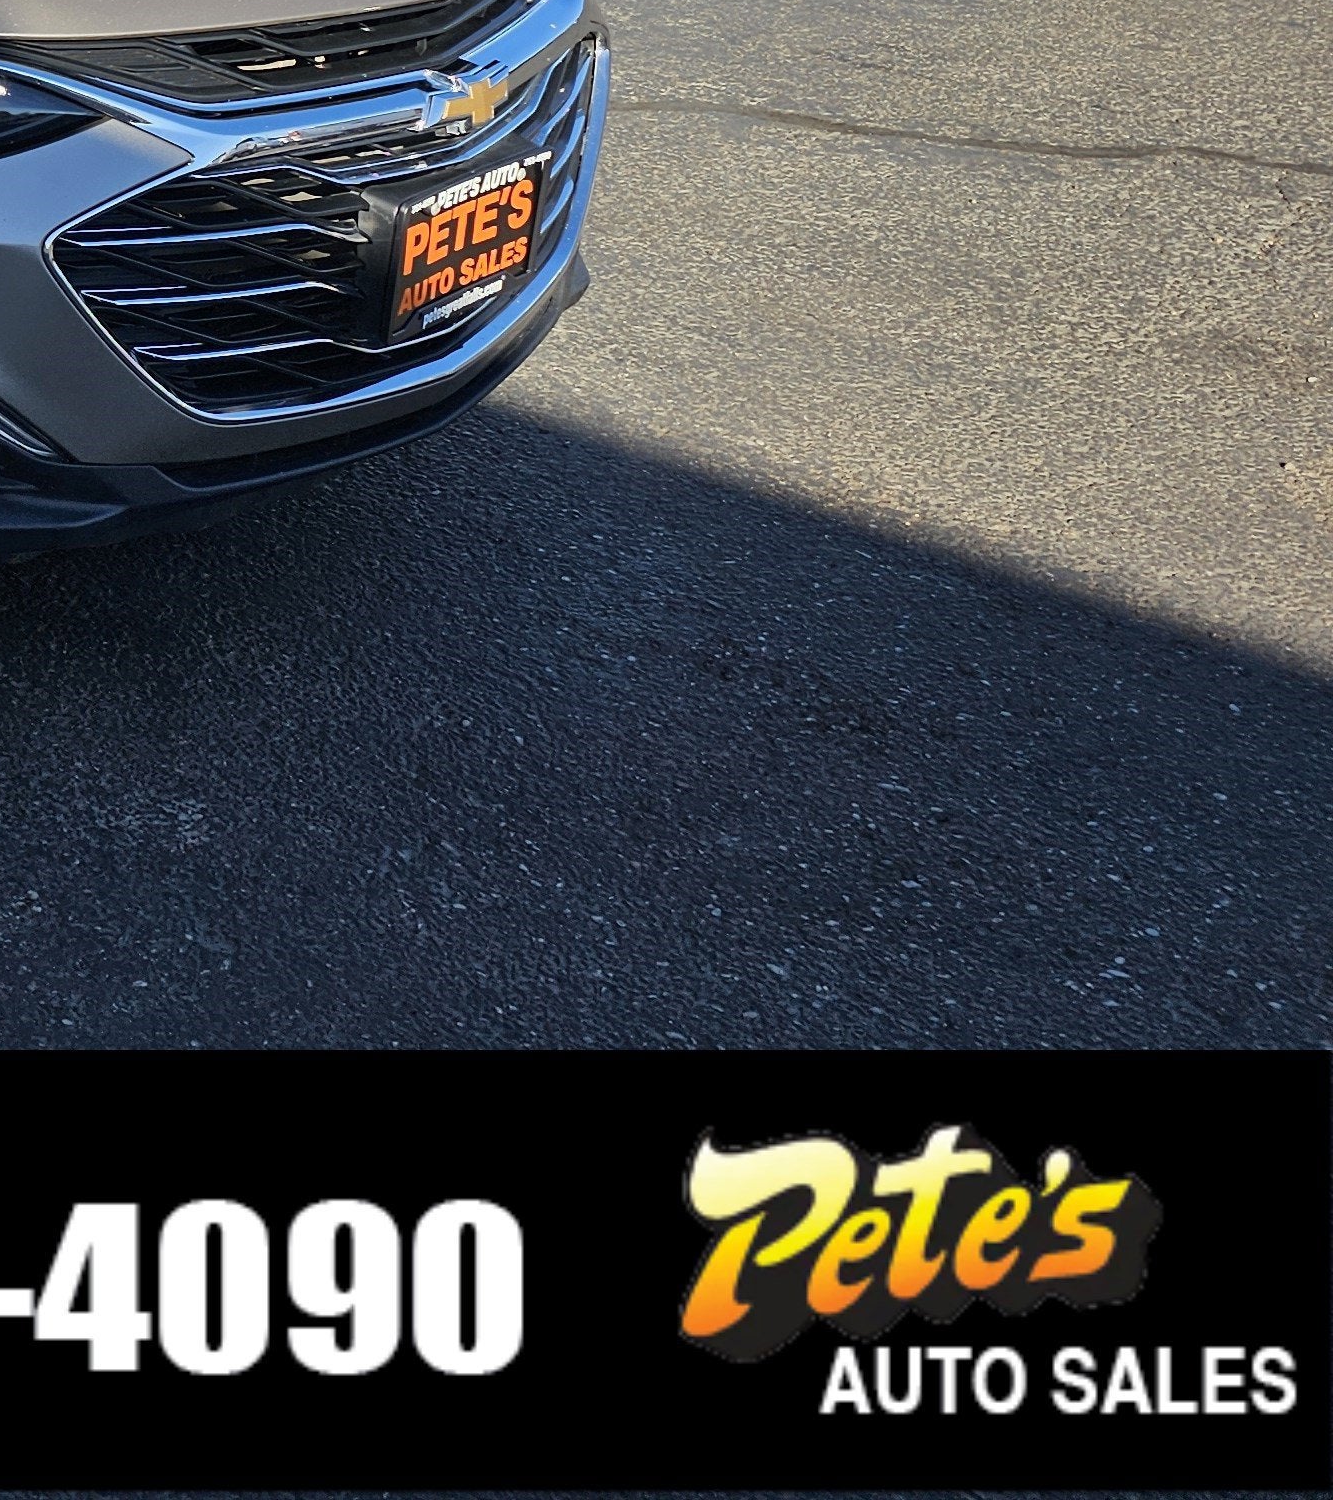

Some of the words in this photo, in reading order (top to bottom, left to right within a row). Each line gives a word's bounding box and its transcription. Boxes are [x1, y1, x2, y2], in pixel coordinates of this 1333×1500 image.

[438, 176, 482, 210] PETE'S
[480, 162, 520, 194] AUTO
[403, 179, 534, 276] PETE'S
[397, 266, 454, 316] AUTO
[459, 236, 528, 286] SALES
